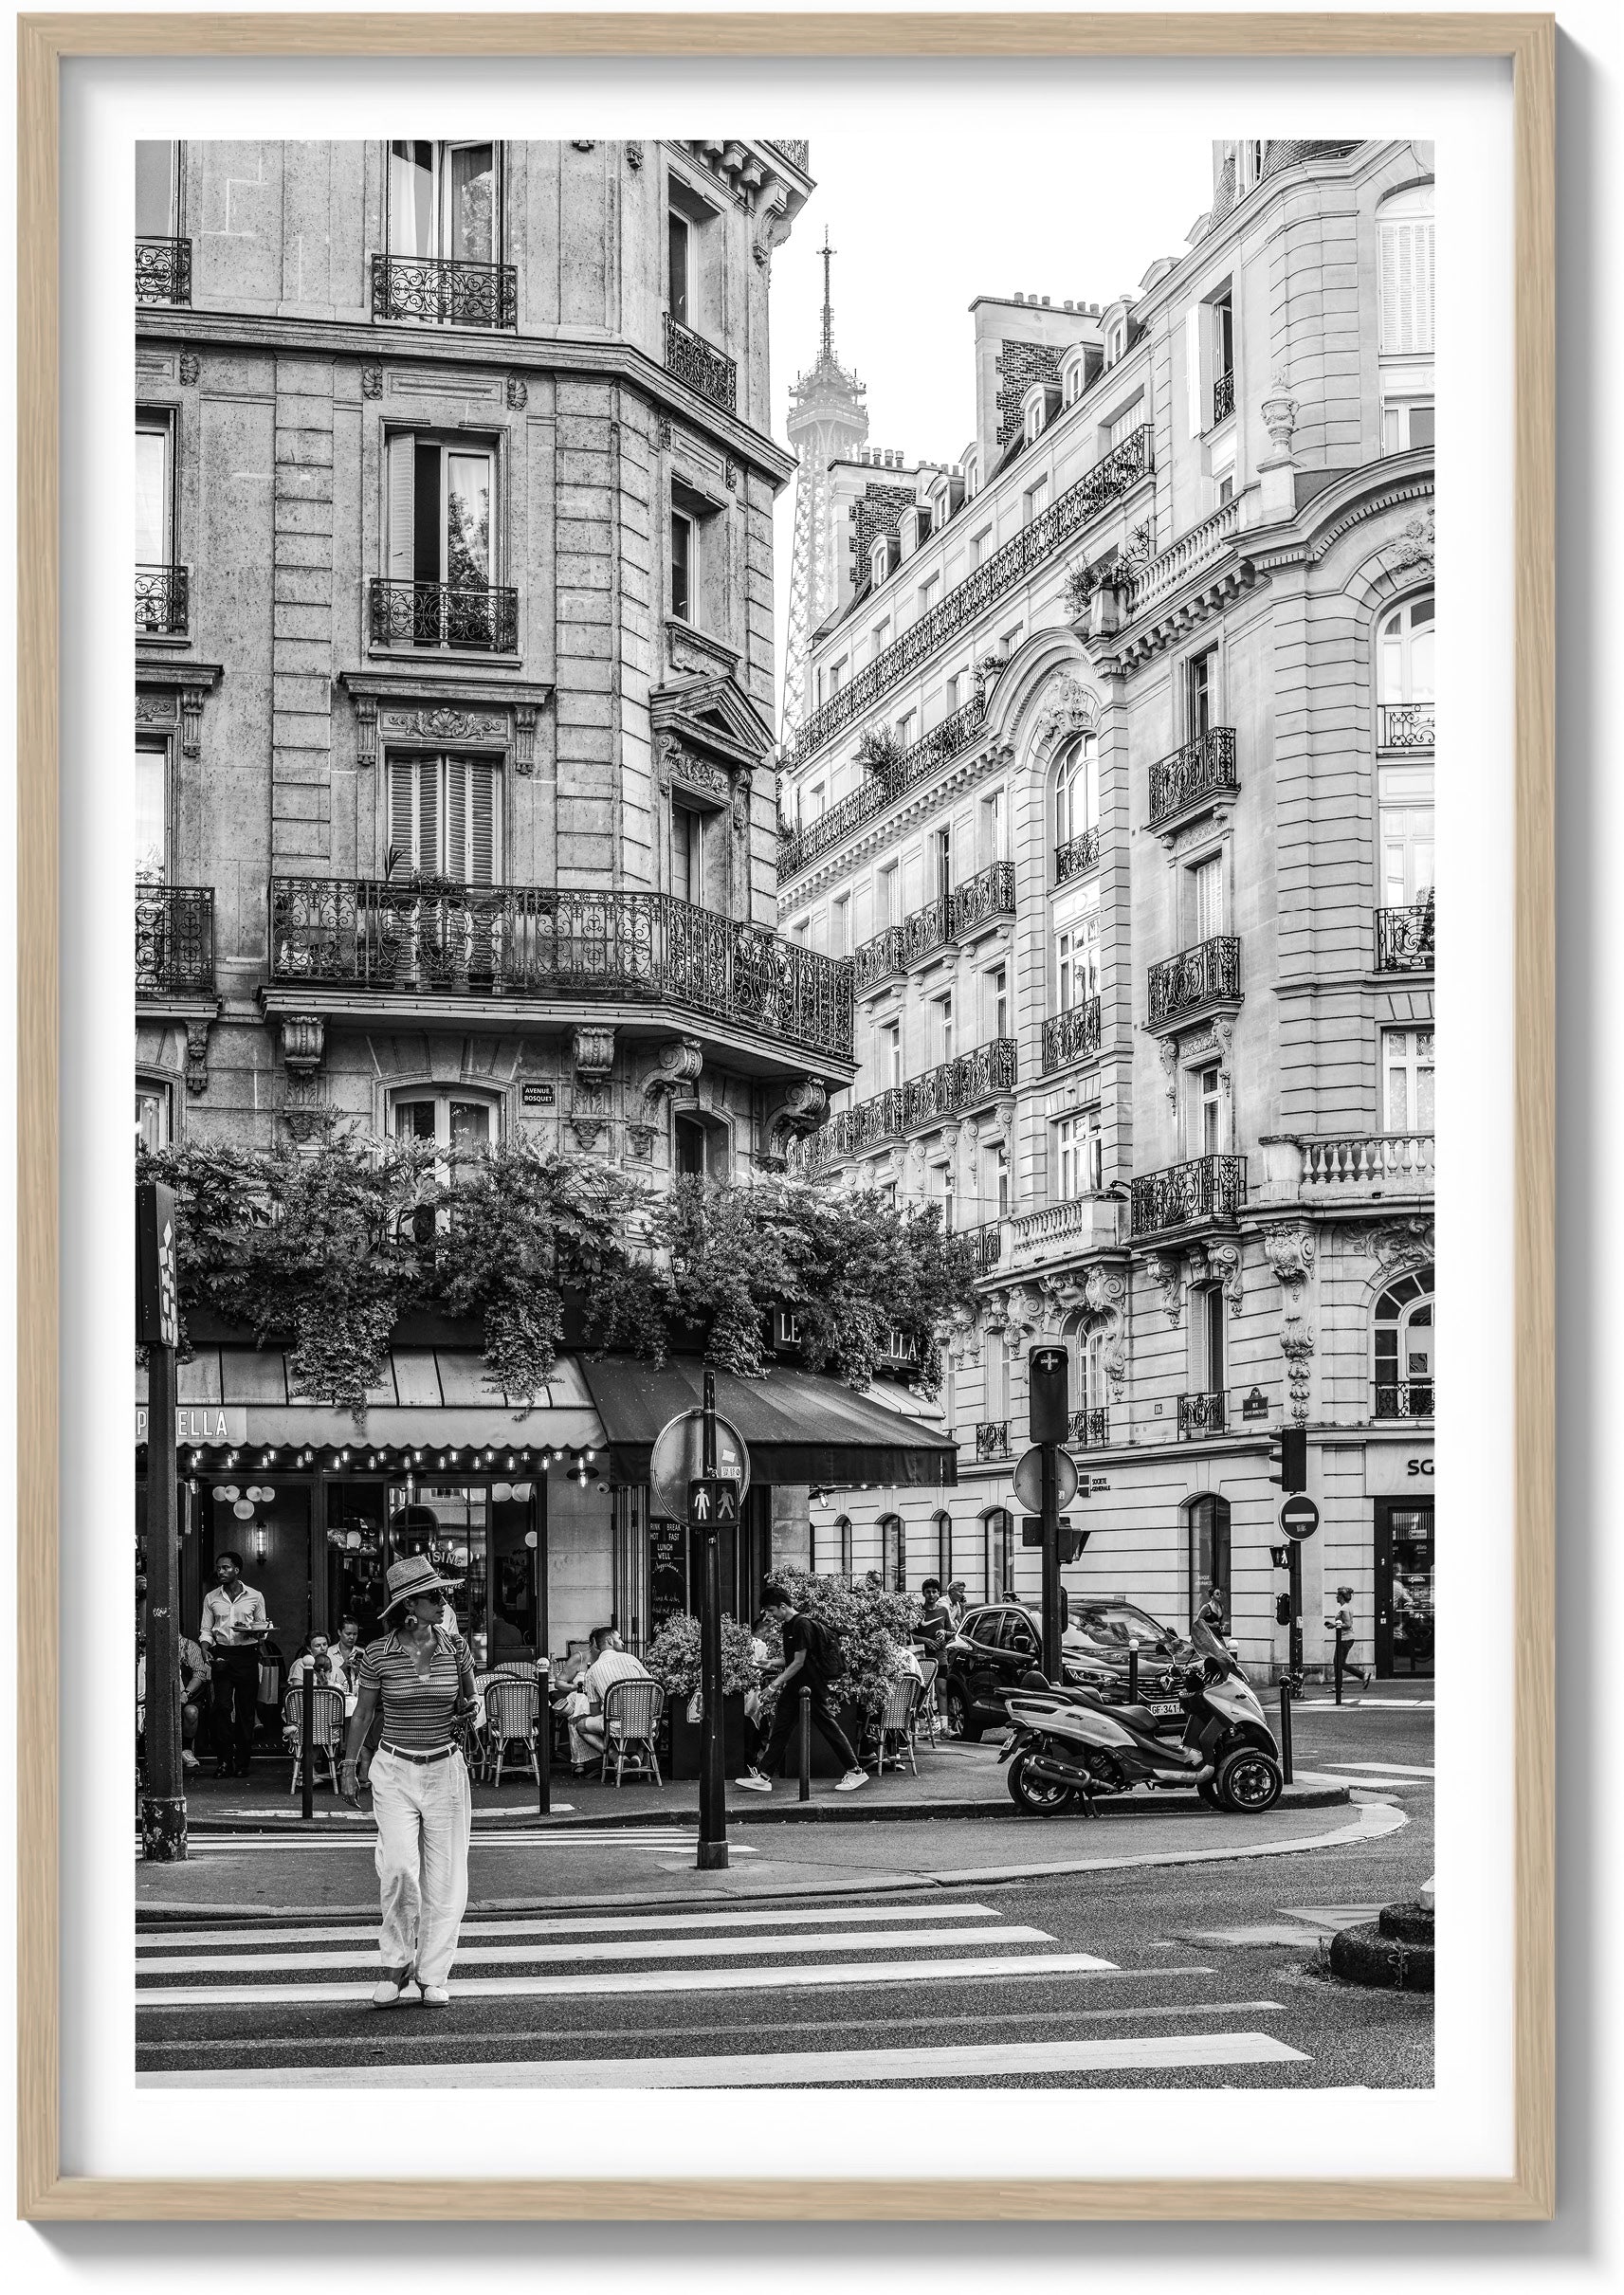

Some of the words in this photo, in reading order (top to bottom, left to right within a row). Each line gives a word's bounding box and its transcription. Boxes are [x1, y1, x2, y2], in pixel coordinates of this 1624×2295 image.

[780, 1313, 802, 1343] LE
[1407, 1459, 1434, 1476] SG
[668, 1533, 680, 1541] FAST
[657, 1543, 673, 1552] LUNCH
[657, 1552, 670, 1560] WELL
